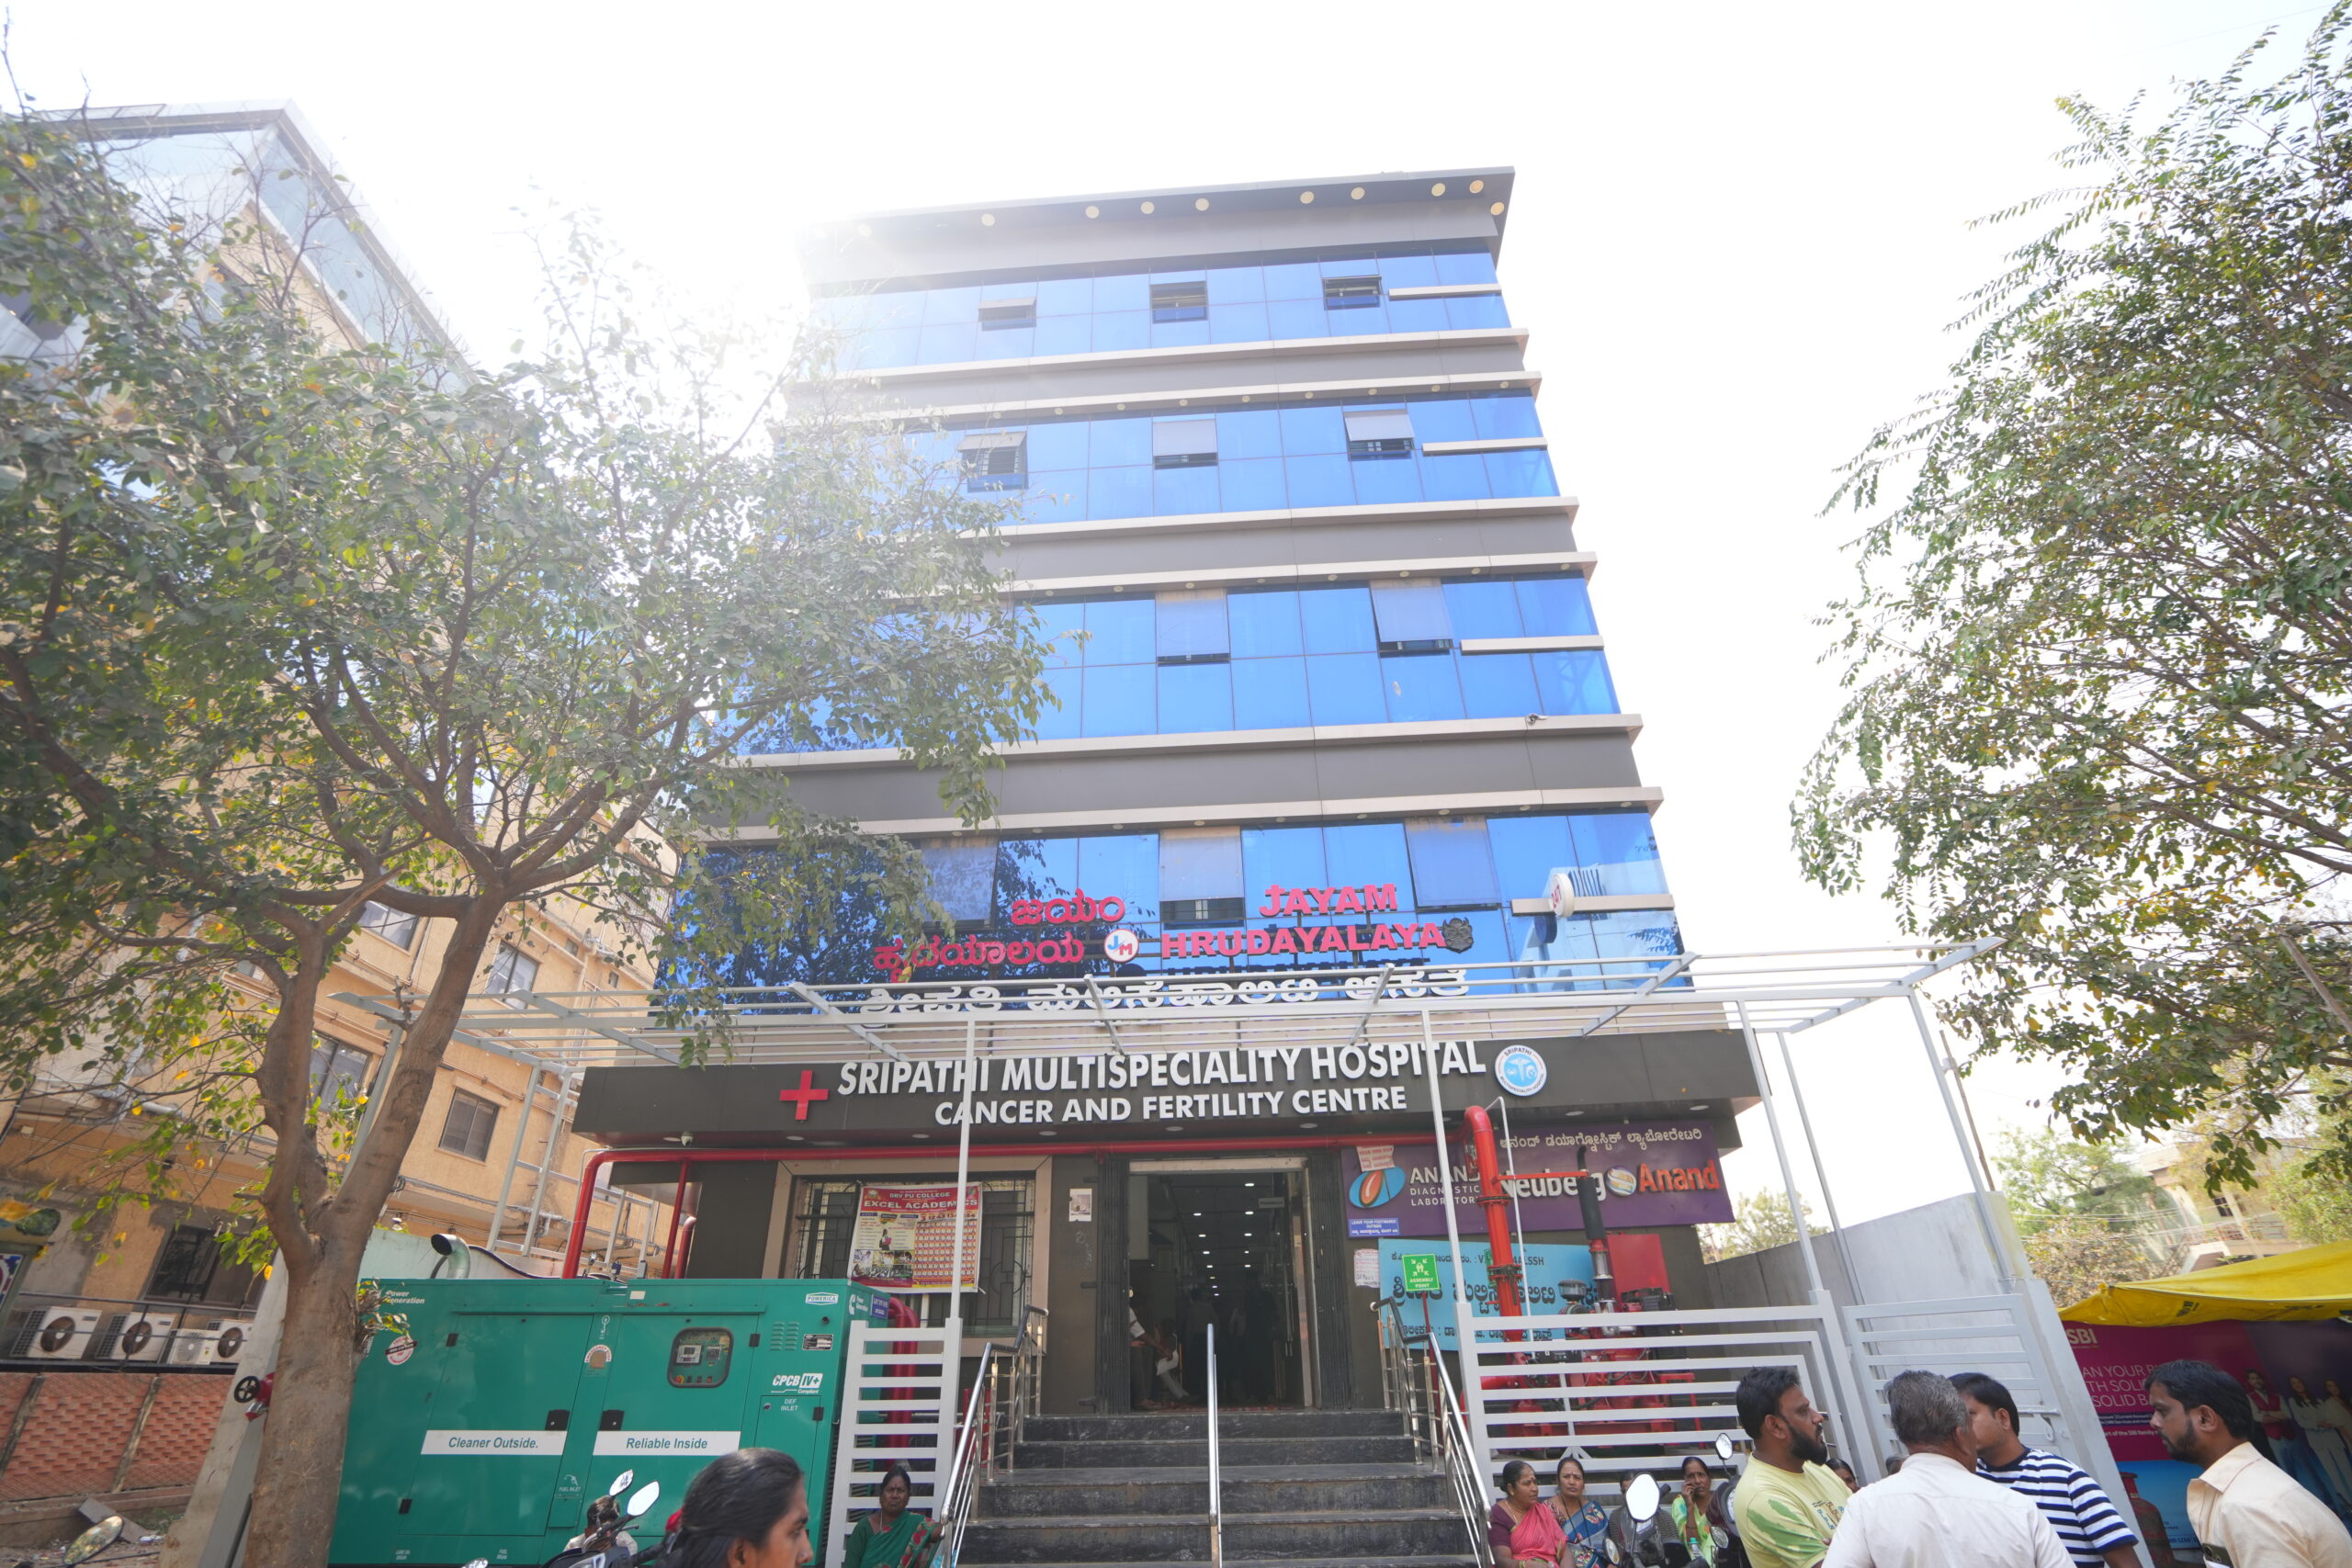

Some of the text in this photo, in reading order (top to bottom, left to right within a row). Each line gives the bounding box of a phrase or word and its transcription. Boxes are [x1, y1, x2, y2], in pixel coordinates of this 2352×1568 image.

[1012, 887, 1125, 925] ಜಯಂ
[1260, 883, 1397, 917] JAYAM
[1161, 922, 1446, 959] HRUDAYALAYA
[837, 1058, 989, 1095] SRIPATHI
[1001, 1047, 1302, 1091] MULTISPECIALITY
[934, 1086, 1408, 1125] CANCER AND FERTILITY CENTRE
[1639, 1159, 1720, 1193] Anand
[1410, 1185, 1480, 1195] DIAGNSTIC
[905, 1199, 978, 1209] ACADEMCS
[1411, 1196, 1478, 1206] LABORTOR
[2066, 1328, 2098, 1344] SBI
[2104, 1365, 2146, 1378] YOUR
[772, 1374, 800, 1386] CPCB
[2109, 1379, 2146, 1393] SOLI
[2093, 1393, 2136, 1407] SOLID
[448, 1437, 538, 1448] Cleaner Outside.
[626, 1438, 707, 1449] Reliable Inside
